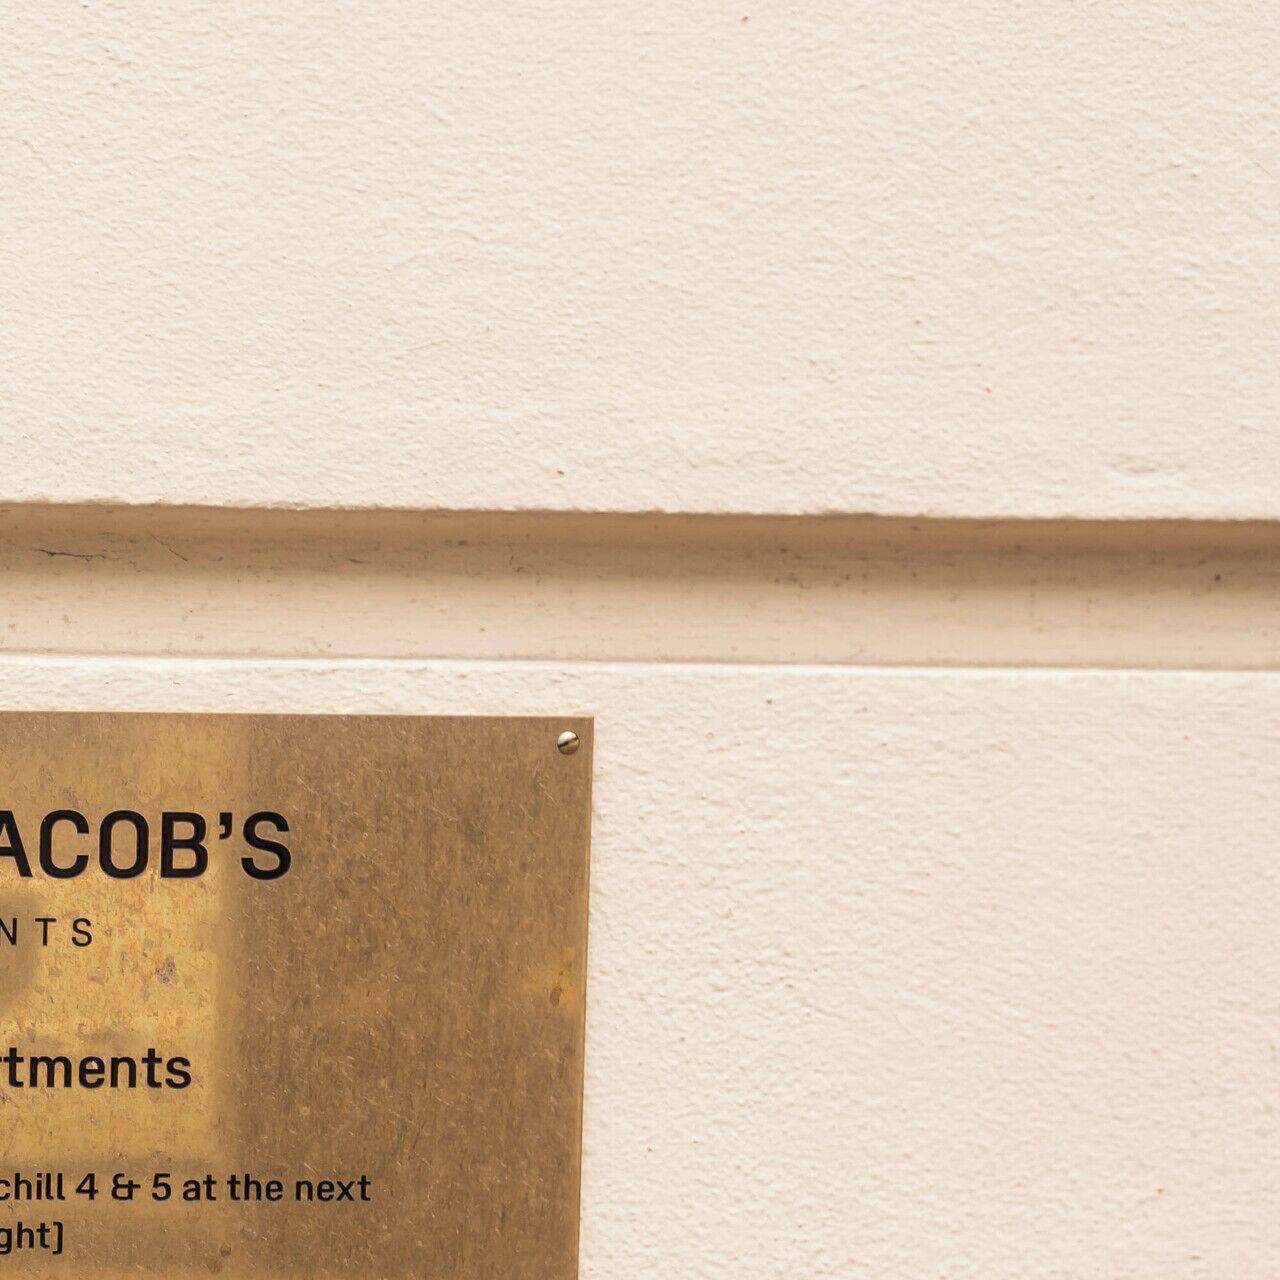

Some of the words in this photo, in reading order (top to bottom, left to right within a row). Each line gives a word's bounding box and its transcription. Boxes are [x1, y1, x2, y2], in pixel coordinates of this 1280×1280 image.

[75, 1172, 99, 1201] 4
[111, 1172, 141, 1201] &
[151, 1172, 172, 1202] 5
[182, 1174, 217, 1202] at
[226, 1173, 284, 1202] the
[295, 1174, 372, 1202] next
